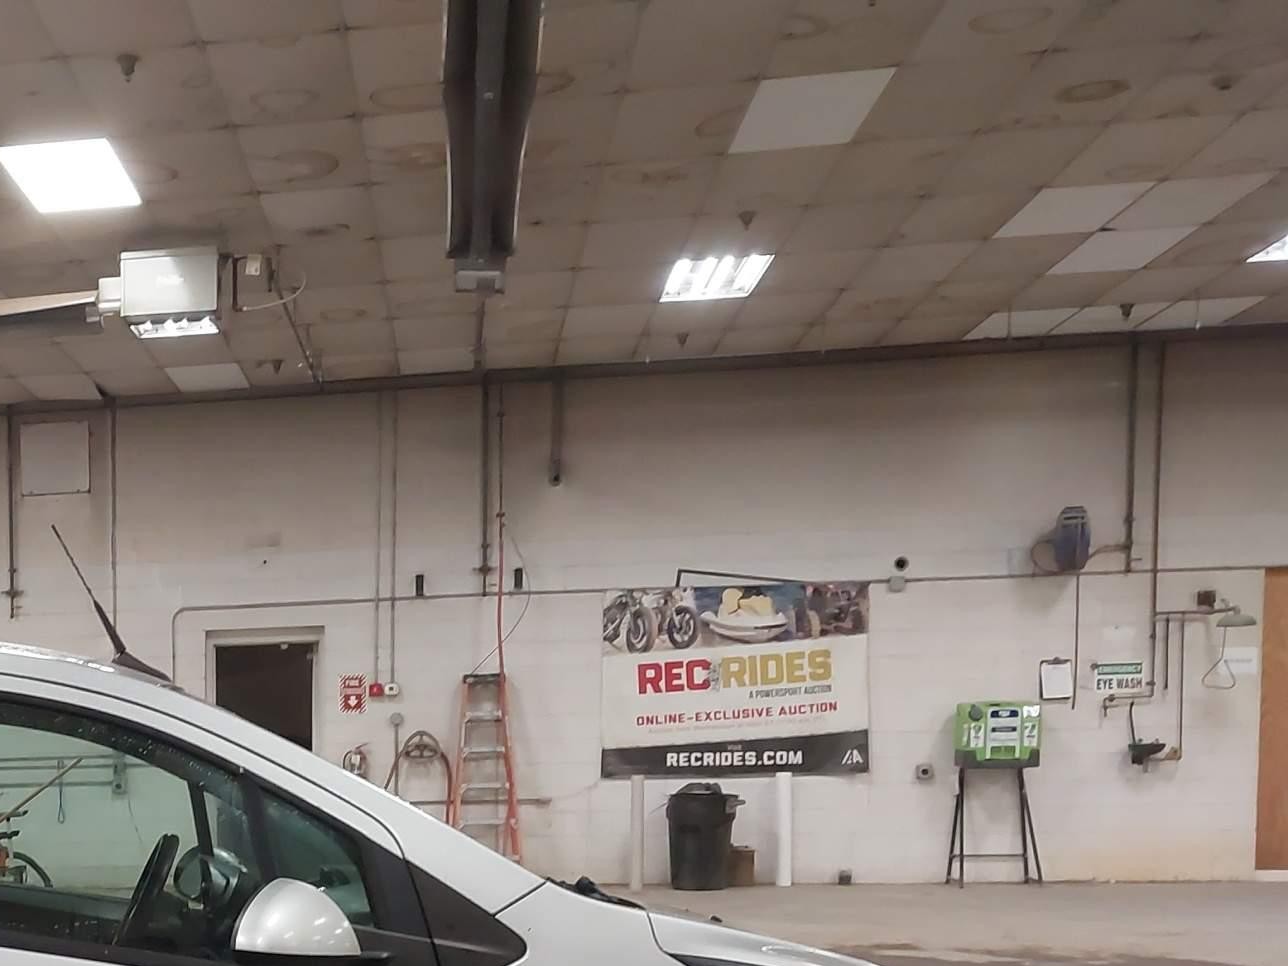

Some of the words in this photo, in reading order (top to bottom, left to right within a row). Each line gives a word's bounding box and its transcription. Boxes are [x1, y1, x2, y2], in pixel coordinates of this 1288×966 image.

[637, 659, 712, 695] REC
[720, 649, 833, 689] RIDES
[1097, 678, 1114, 690] EYE
[1116, 677, 1143, 689] WASH
[636, 707, 773, 726] ONLINE-EXCLUSIVE
[778, 701, 838, 717] AUCTION
[666, 750, 803, 767] RECRIDES.COM
